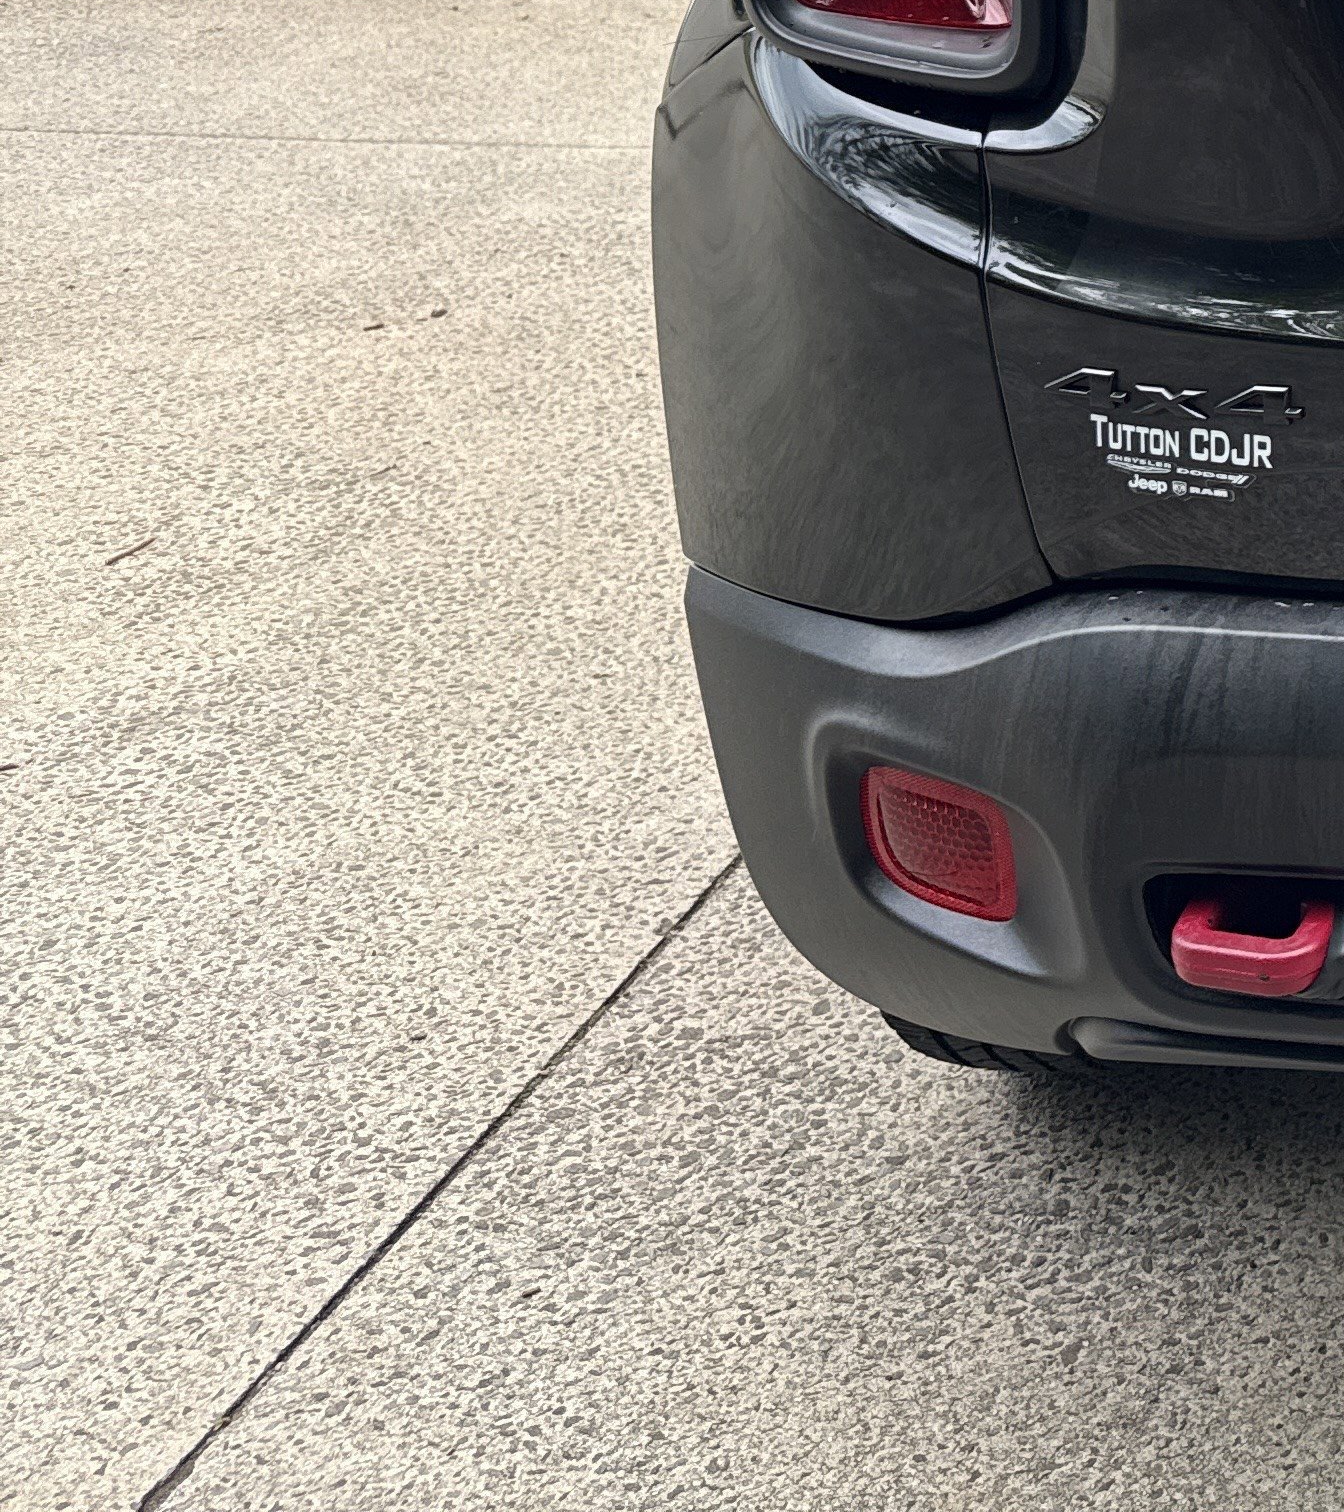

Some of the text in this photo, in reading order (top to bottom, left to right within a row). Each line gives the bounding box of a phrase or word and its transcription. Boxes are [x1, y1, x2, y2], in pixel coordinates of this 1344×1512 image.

[1090, 413, 1273, 469] TUTTON CDJR
[1106, 453, 1172, 468] CHRYSLER
[1128, 474, 1168, 494] Jeep
[1189, 486, 1228, 497] RAM
